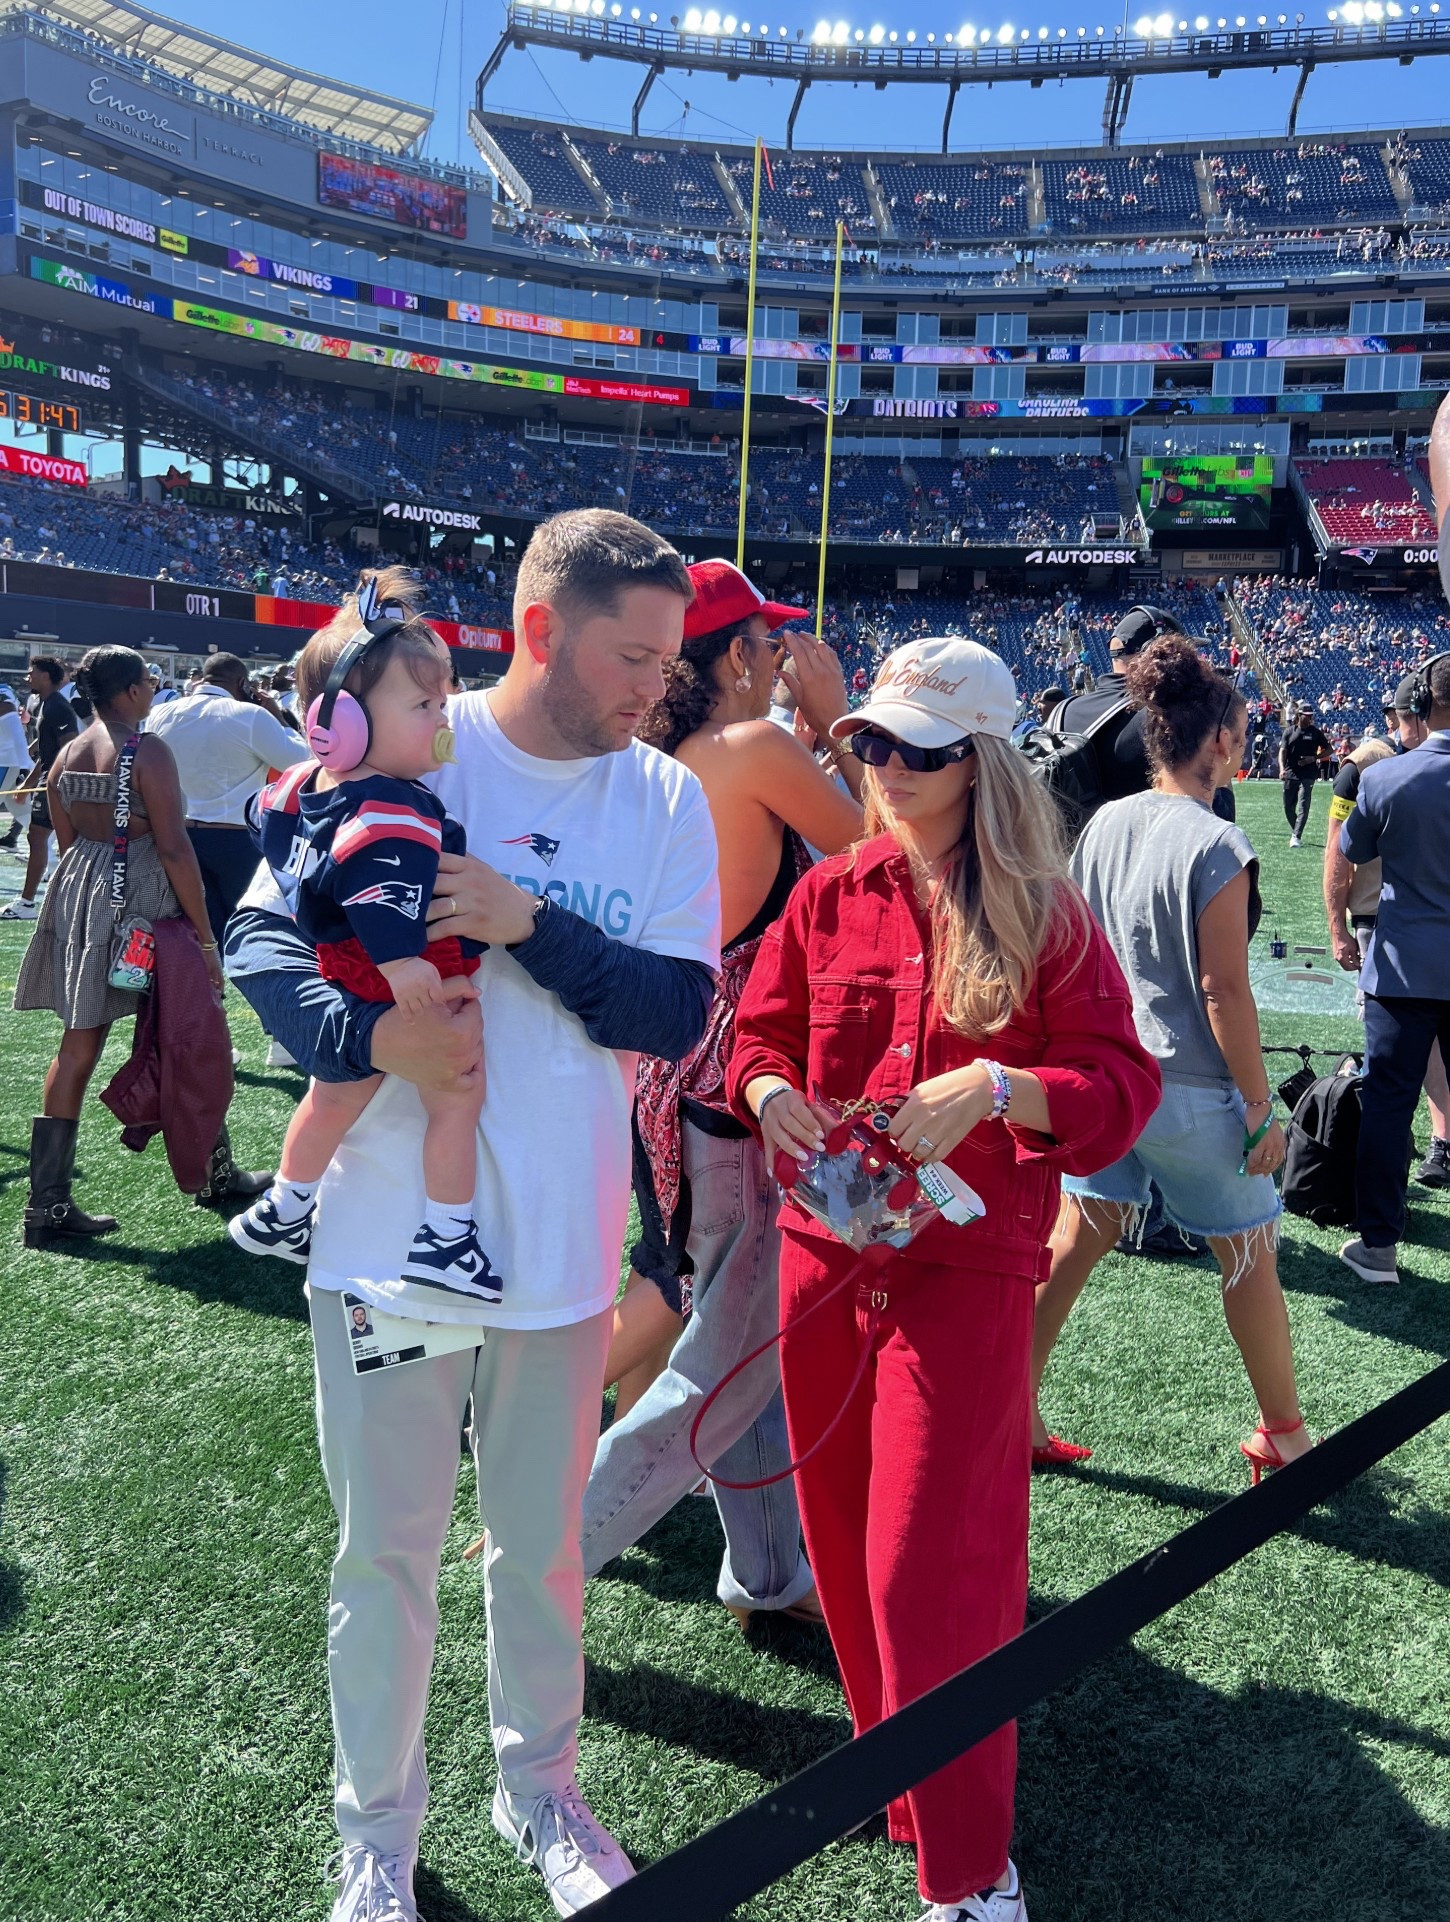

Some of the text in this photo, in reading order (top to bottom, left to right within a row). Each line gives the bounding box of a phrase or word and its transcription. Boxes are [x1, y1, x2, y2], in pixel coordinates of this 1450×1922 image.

[88, 76, 191, 141] Encore
[97, 112, 183, 156] BOSTON HARBOR
[203, 137, 265, 167] TERRACE
[44, 188, 156, 243] OUT OF TOWN SCORES
[272, 262, 333, 291] VIKINGS
[101, 286, 155, 313] Mutual
[404, 295, 419, 310] 21
[186, 309, 220, 325] Gillette
[495, 311, 563, 335] STEELERS
[618, 329, 635, 342] 24
[656, 334, 664, 345] 4
[698, 344, 721, 352] LIGHT
[1231, 348, 1256, 356] LIGHT
[1235, 342, 1253, 350] BUD
[870, 352, 893, 361] LIGHT
[0, 352, 111, 391] DRAFTKINGS
[492, 371, 522, 383] Gillette
[630, 388, 652, 398] Heart
[653, 390, 680, 402] Pumps
[19, 454, 85, 484] TOYOTA
[1162, 465, 1205, 477] Gillette
[402, 504, 482, 530] AUTODESK
[1046, 550, 1137, 564] AUTODESK
[1208, 552, 1256, 561] MARKETPLACE
[1403, 549, 1439, 564] 0:00
[212, 597, 220, 617] 1
[458, 624, 502, 649] Optum
[892, 659, 968, 698] England
[115, 755, 134, 828] HAWKINS
[935, 1177, 948, 1196] WEEK
[381, 1352, 401, 1366] TEAM
